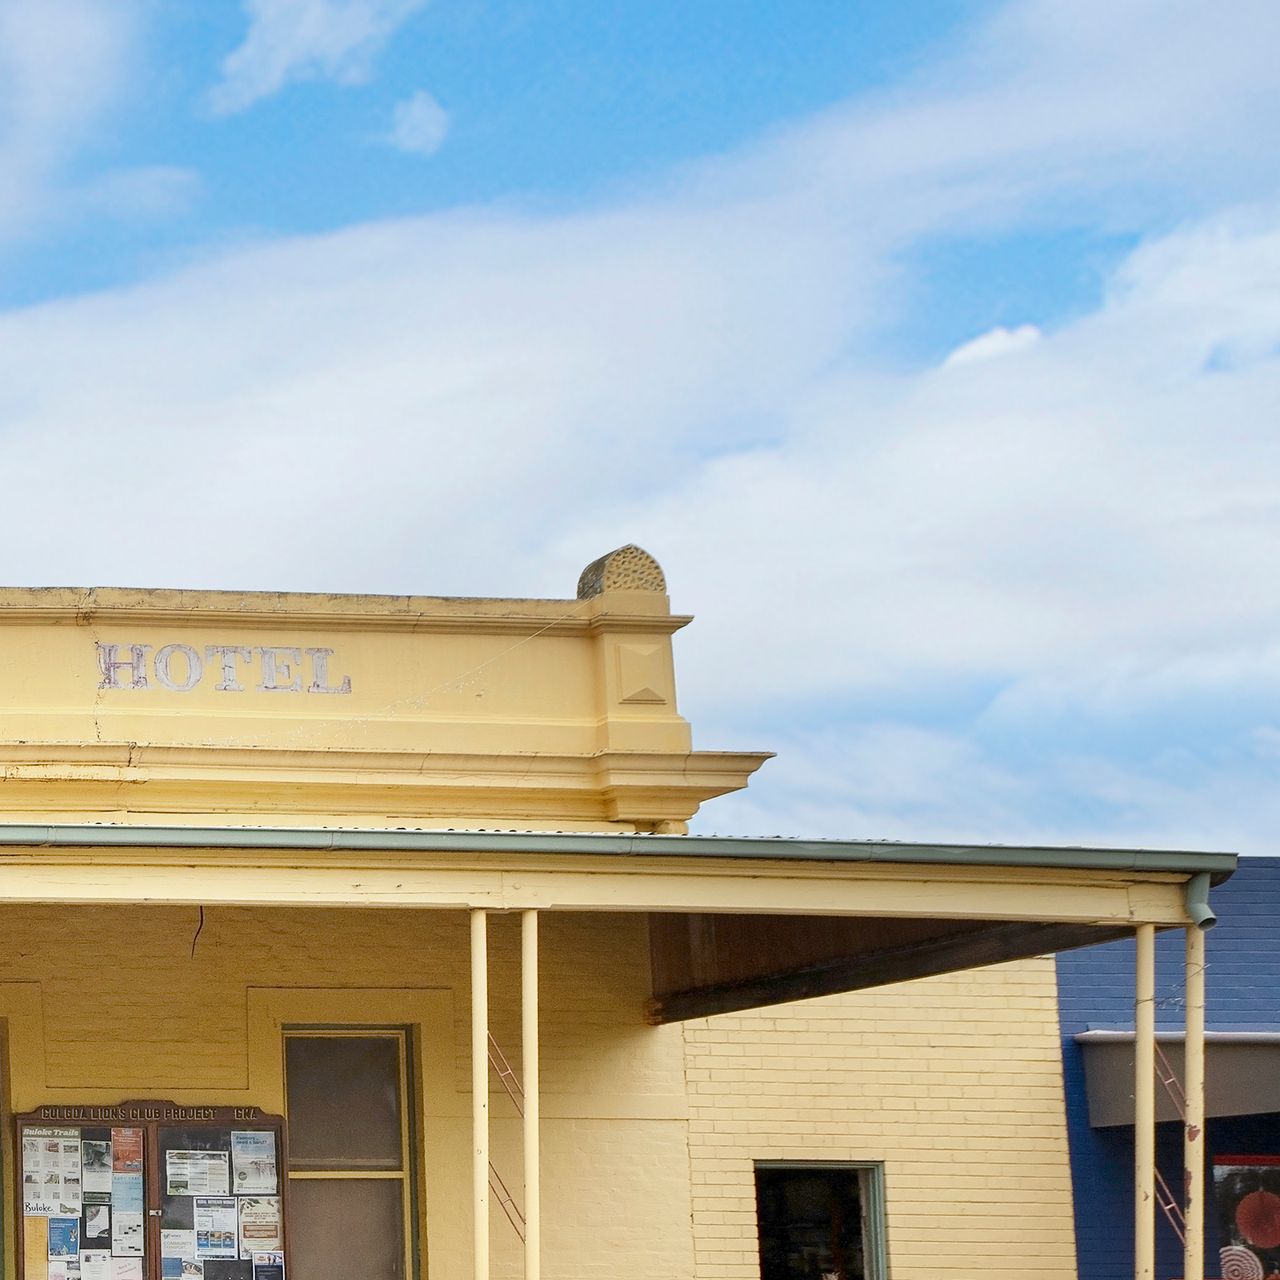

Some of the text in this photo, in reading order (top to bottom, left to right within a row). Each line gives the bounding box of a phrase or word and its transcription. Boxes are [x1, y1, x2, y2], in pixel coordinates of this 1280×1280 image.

[97, 643, 352, 694] HOTEL
[129, 1108, 160, 1120] CLUB
[164, 1108, 216, 1120] PROJECT
[53, 1128, 79, 1136] Trails
